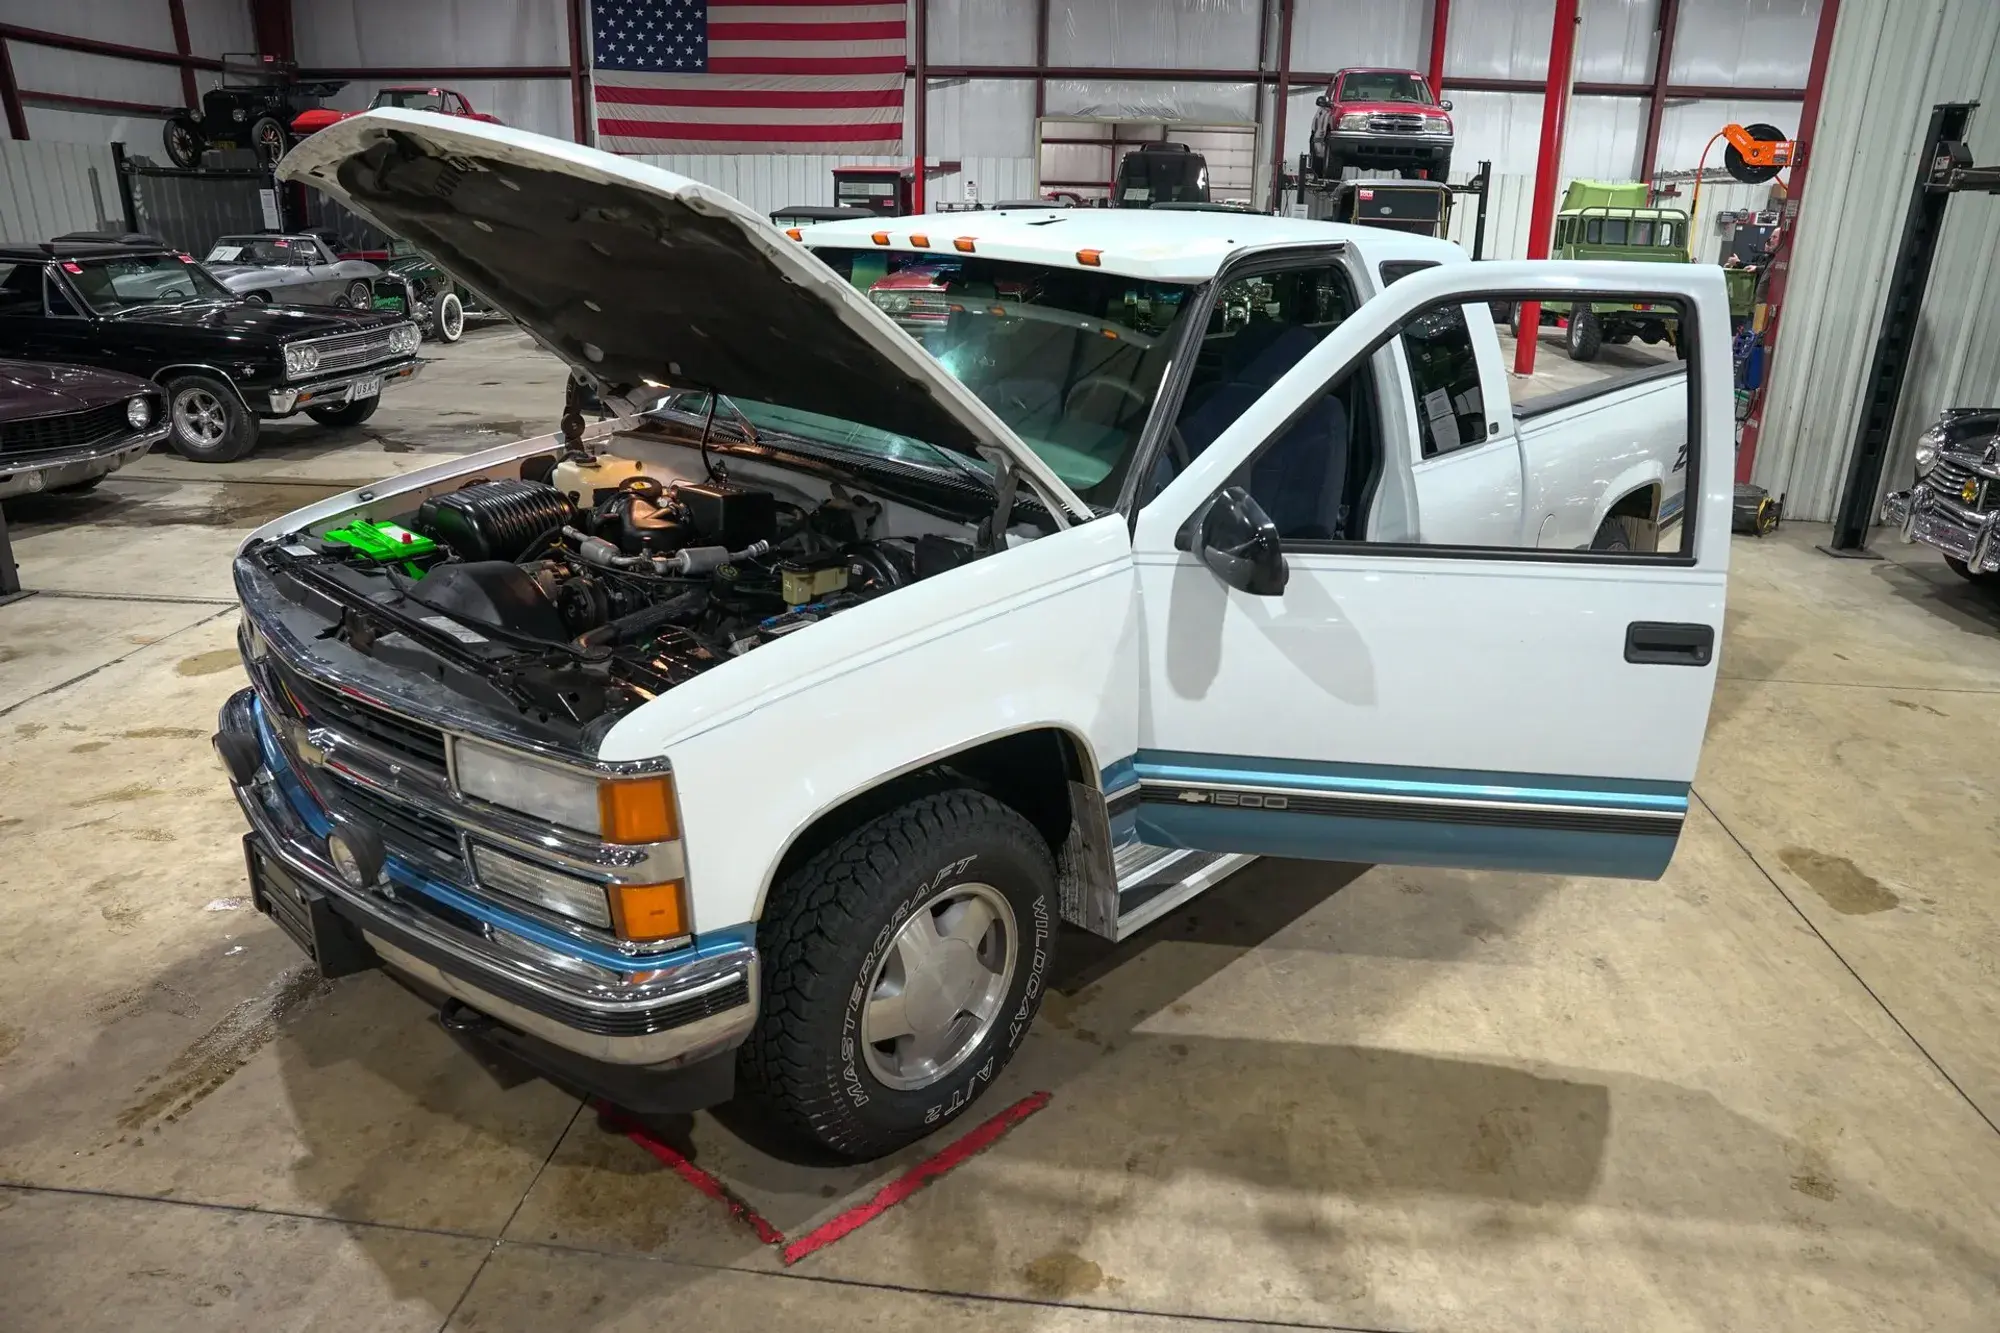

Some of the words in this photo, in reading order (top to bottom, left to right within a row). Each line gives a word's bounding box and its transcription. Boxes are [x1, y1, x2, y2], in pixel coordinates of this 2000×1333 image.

[357, 380, 378, 395] USA-1
[1210, 793, 1288, 809] 1500
[841, 854, 978, 1108] MASTERCRAFT
[1009, 895, 1049, 1048] WILDCAT
